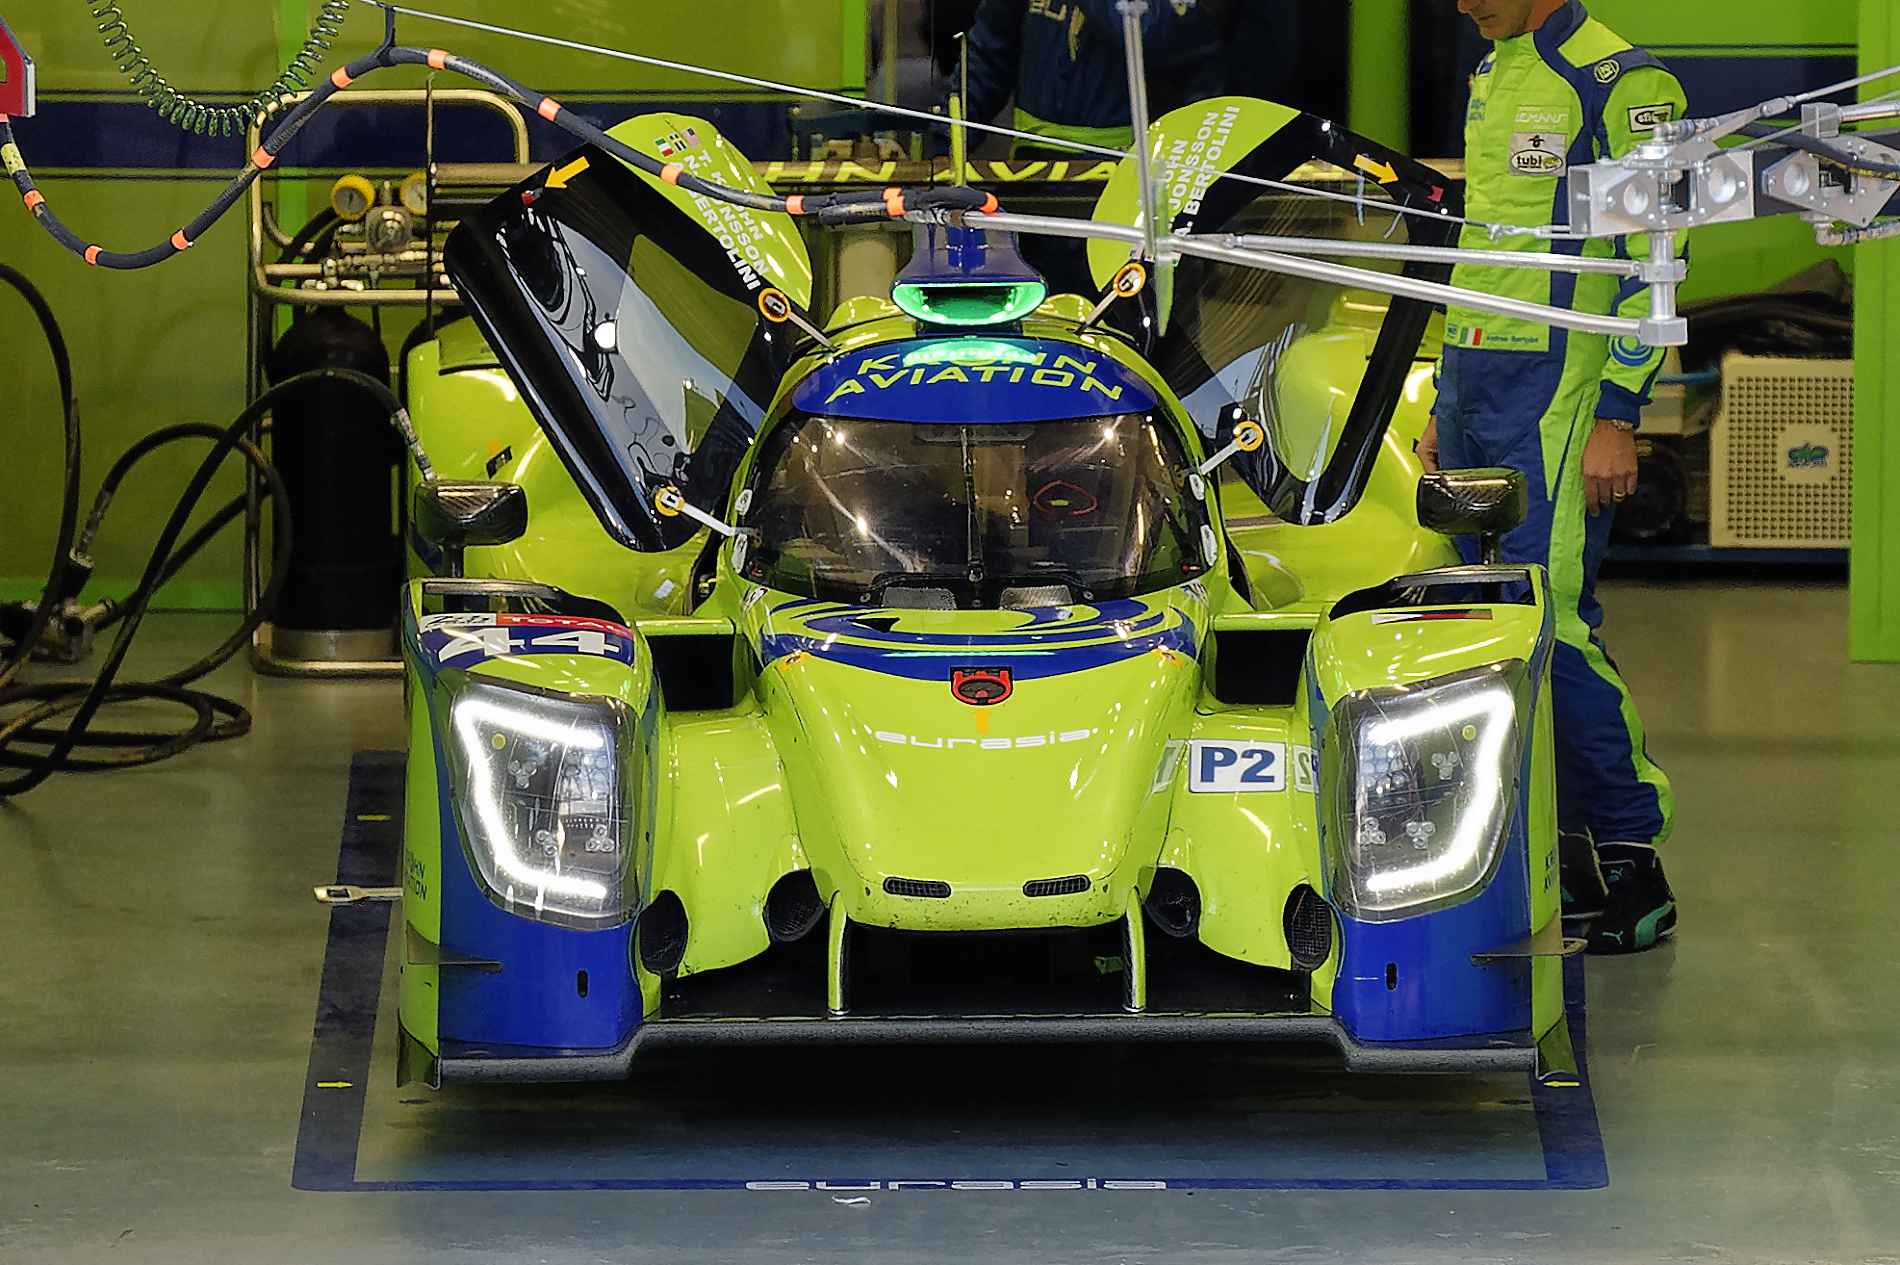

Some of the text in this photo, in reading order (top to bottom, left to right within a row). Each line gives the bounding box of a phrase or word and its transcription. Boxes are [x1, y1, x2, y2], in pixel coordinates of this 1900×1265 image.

[932, 160, 1119, 182] AVIA
[1182, 104, 1240, 215] BERTOLINI
[711, 198, 769, 276] NSSON
[824, 366, 1124, 404] AVIATION
[503, 616, 626, 636] TOTAL
[438, 627, 620, 663] 44
[875, 729, 1090, 749] eurasia
[1201, 747, 1275, 782] P2
